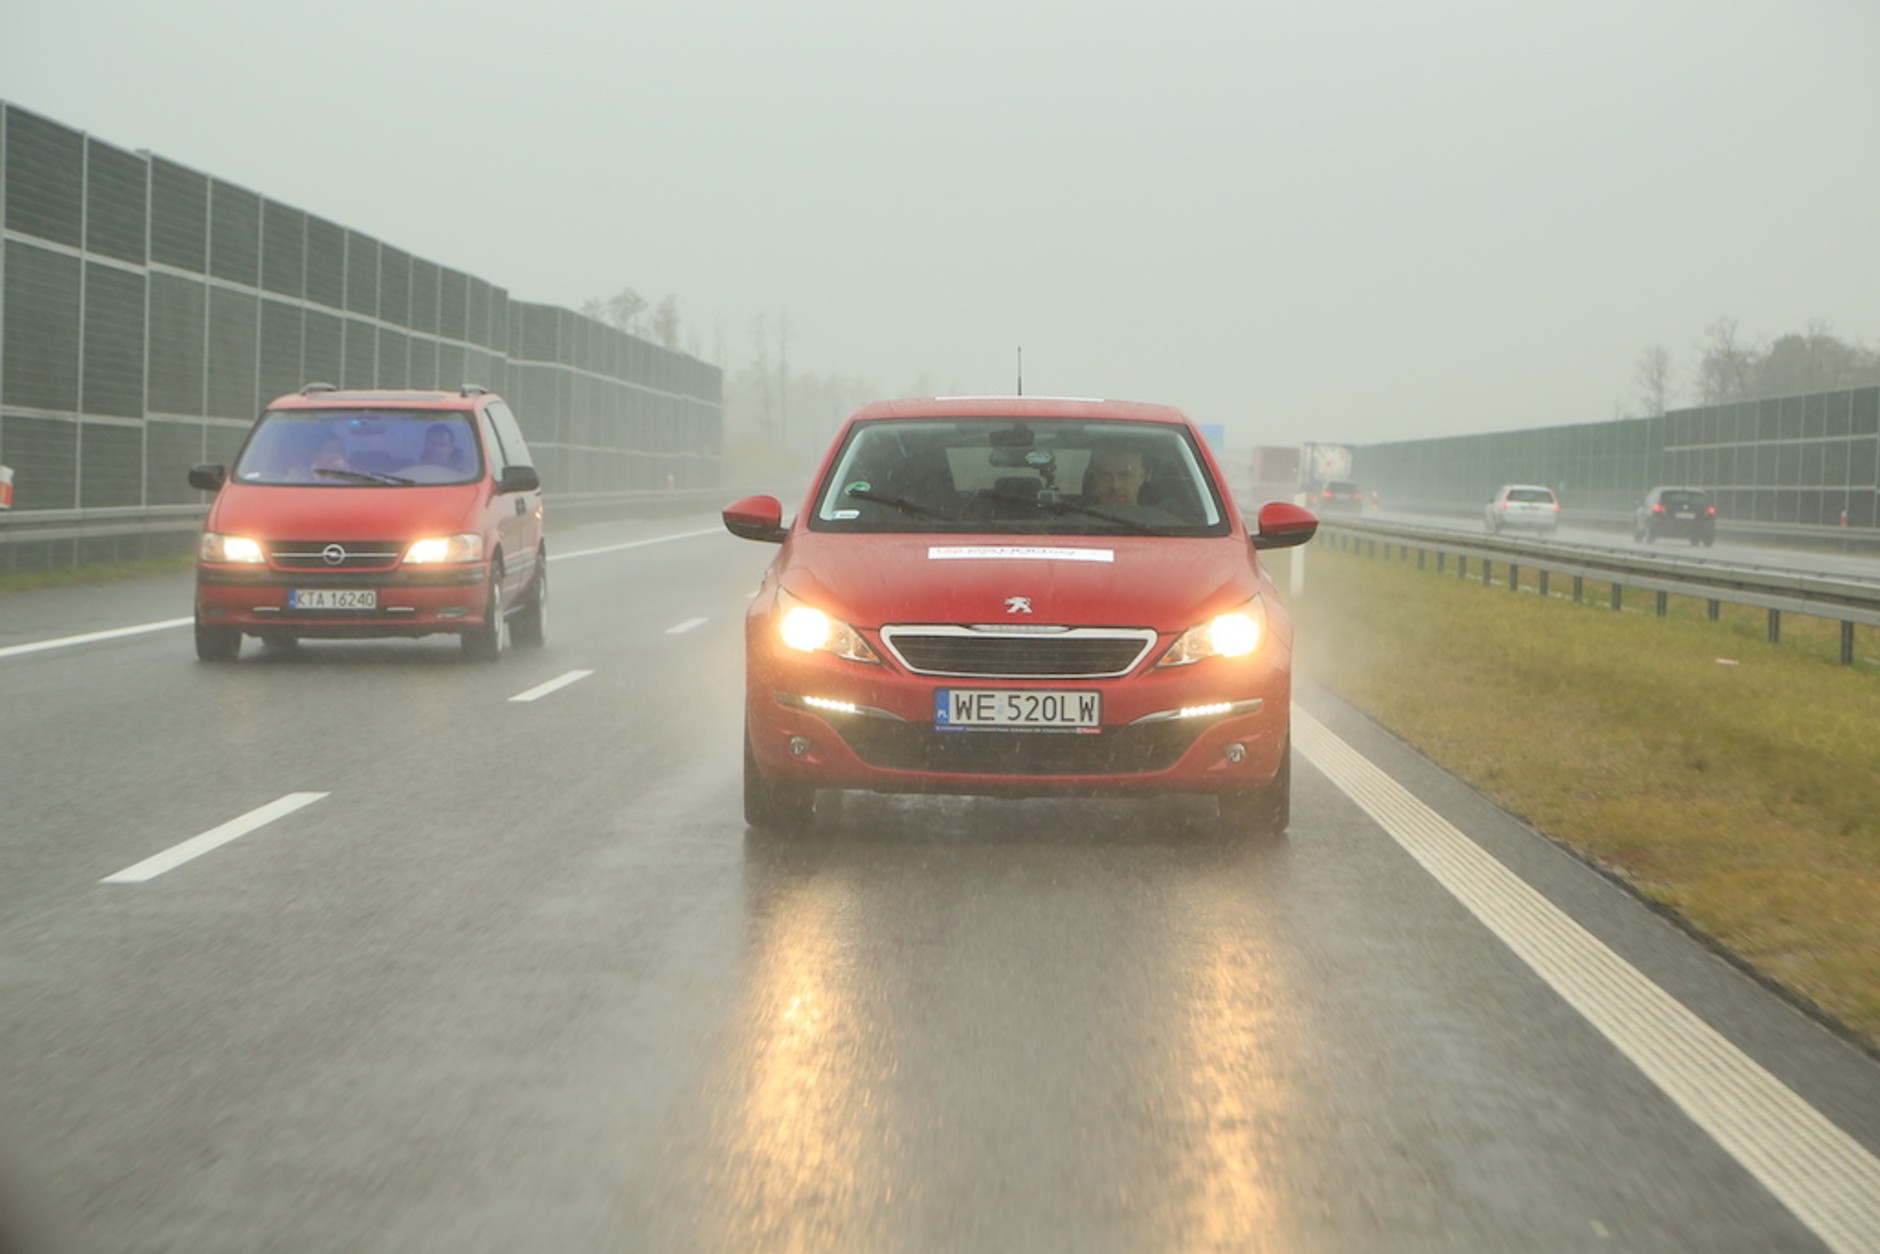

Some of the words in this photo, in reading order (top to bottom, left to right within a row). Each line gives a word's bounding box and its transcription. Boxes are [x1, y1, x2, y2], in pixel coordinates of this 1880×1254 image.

[298, 592, 325, 606] KTA
[331, 592, 375, 607] 16240
[955, 694, 995, 721] WE
[1007, 695, 1096, 723] 520LW
